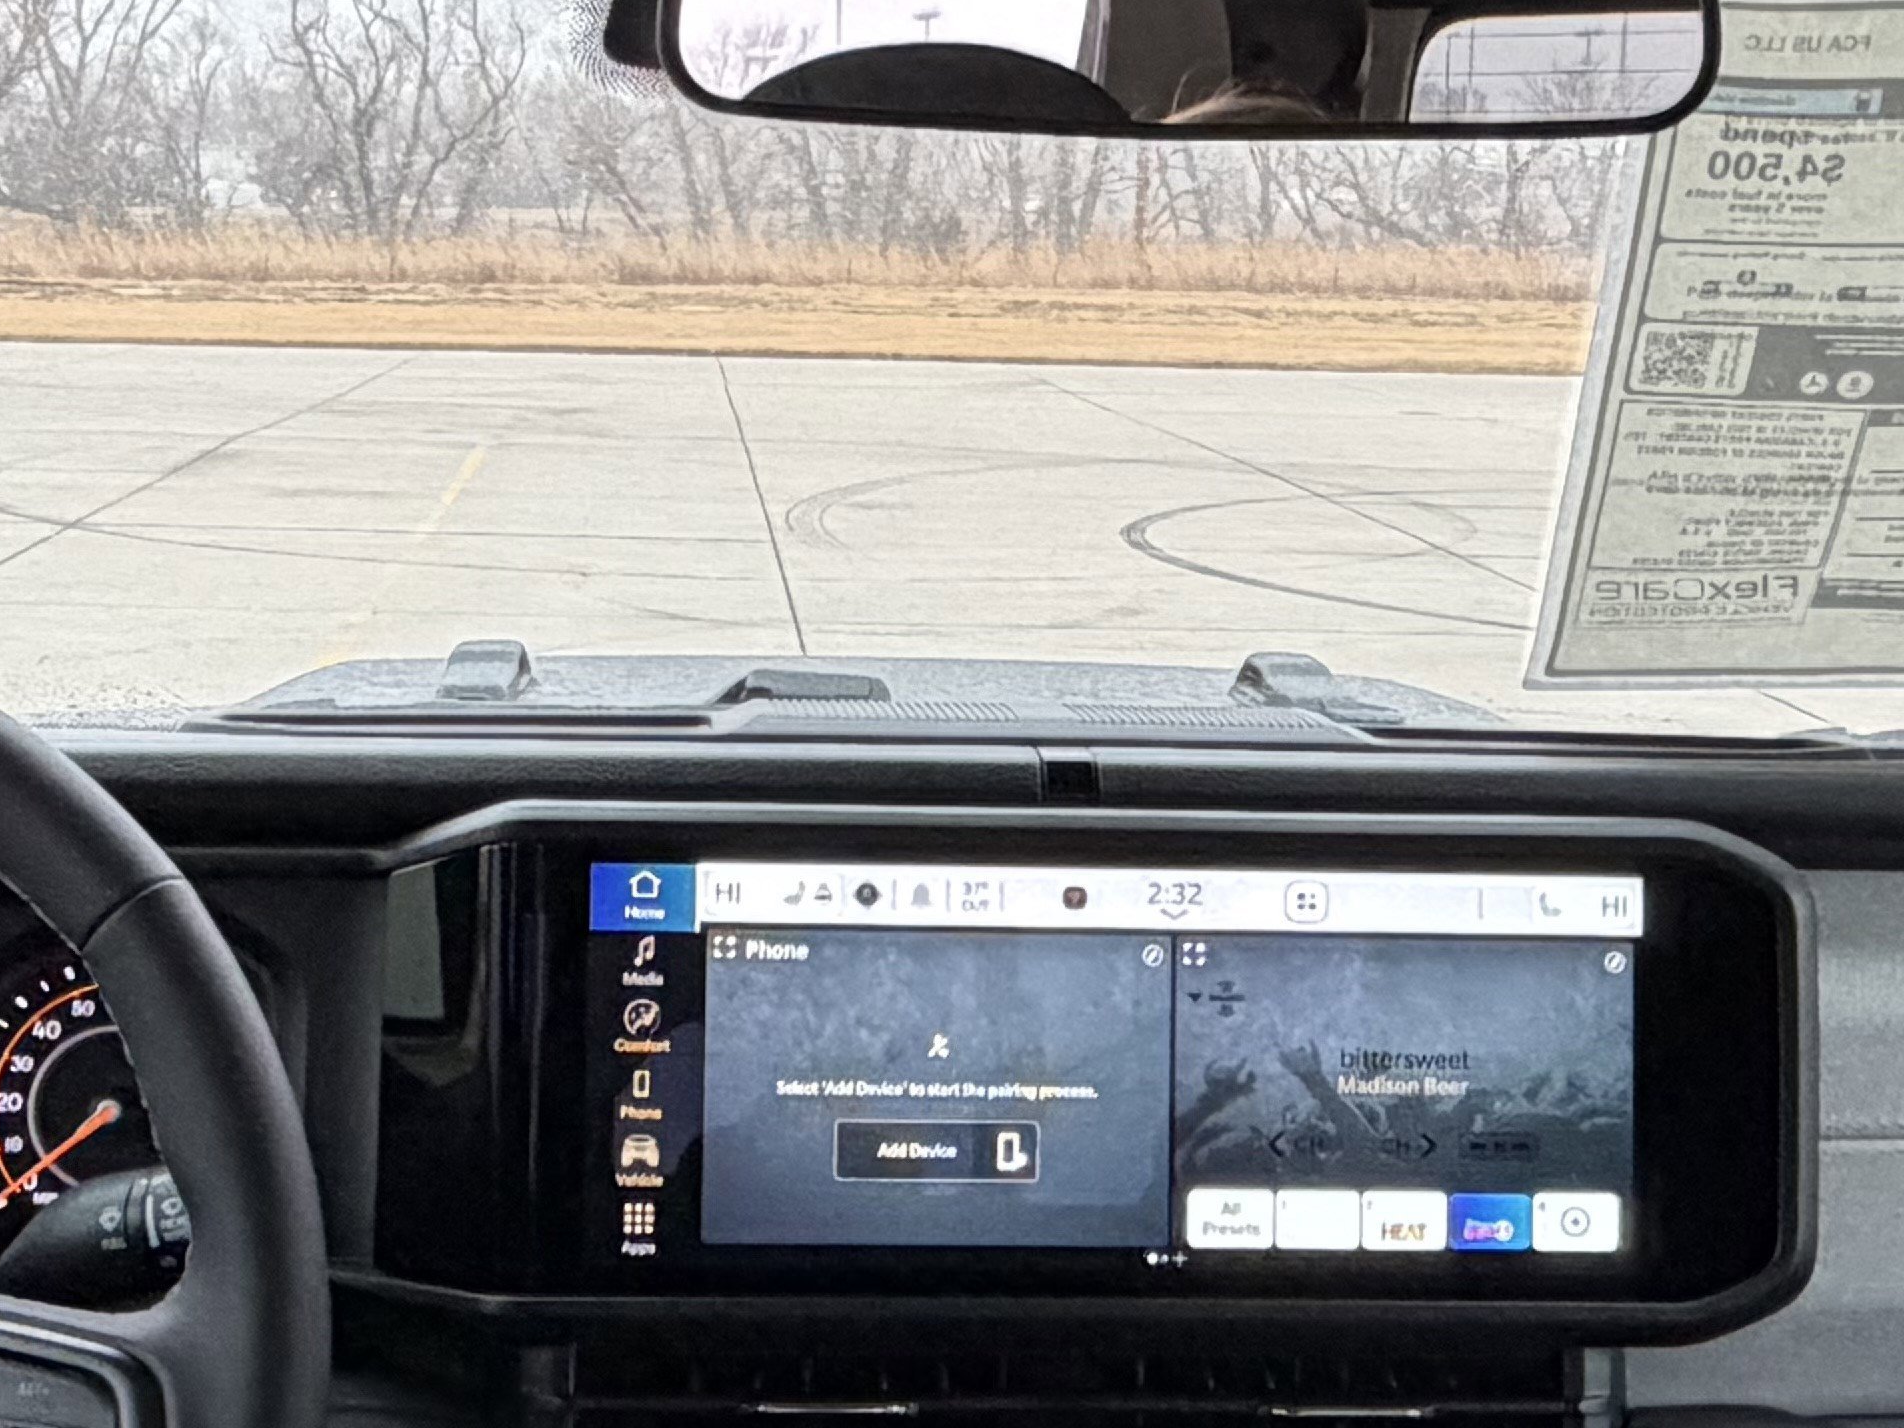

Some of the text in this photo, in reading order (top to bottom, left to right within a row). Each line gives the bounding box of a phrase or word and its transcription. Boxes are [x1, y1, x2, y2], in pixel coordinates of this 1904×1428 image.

[714, 883, 742, 906] HI
[1147, 882, 1203, 905] 2:32
[624, 905, 666, 921] Home
[1601, 895, 1629, 918] HI
[745, 940, 810, 962] Phone
[622, 972, 664, 987] Media
[32, 1022, 62, 1040] 40
[613, 1037, 671, 1054] Comfort
[11, 1055, 34, 1072] 30
[1339, 1047, 1472, 1072] bittersweet
[776, 1080, 818, 1096] Select
[909, 1082, 924, 1098] to
[927, 1082, 960, 1098] start
[963, 1083, 986, 1098] the
[988, 1083, 1037, 1101] pairing
[1337, 1076, 1470, 1099] Madison Beer
[620, 1105, 663, 1121] Phone
[4, 1136, 24, 1153] 10
[876, 1143, 958, 1159] Add Device
[615, 1173, 665, 1188] Vehicle
[1201, 1221, 1261, 1237] Presets
[1380, 1222, 1427, 1241] HEAT
[621, 1240, 657, 1257] Apps
